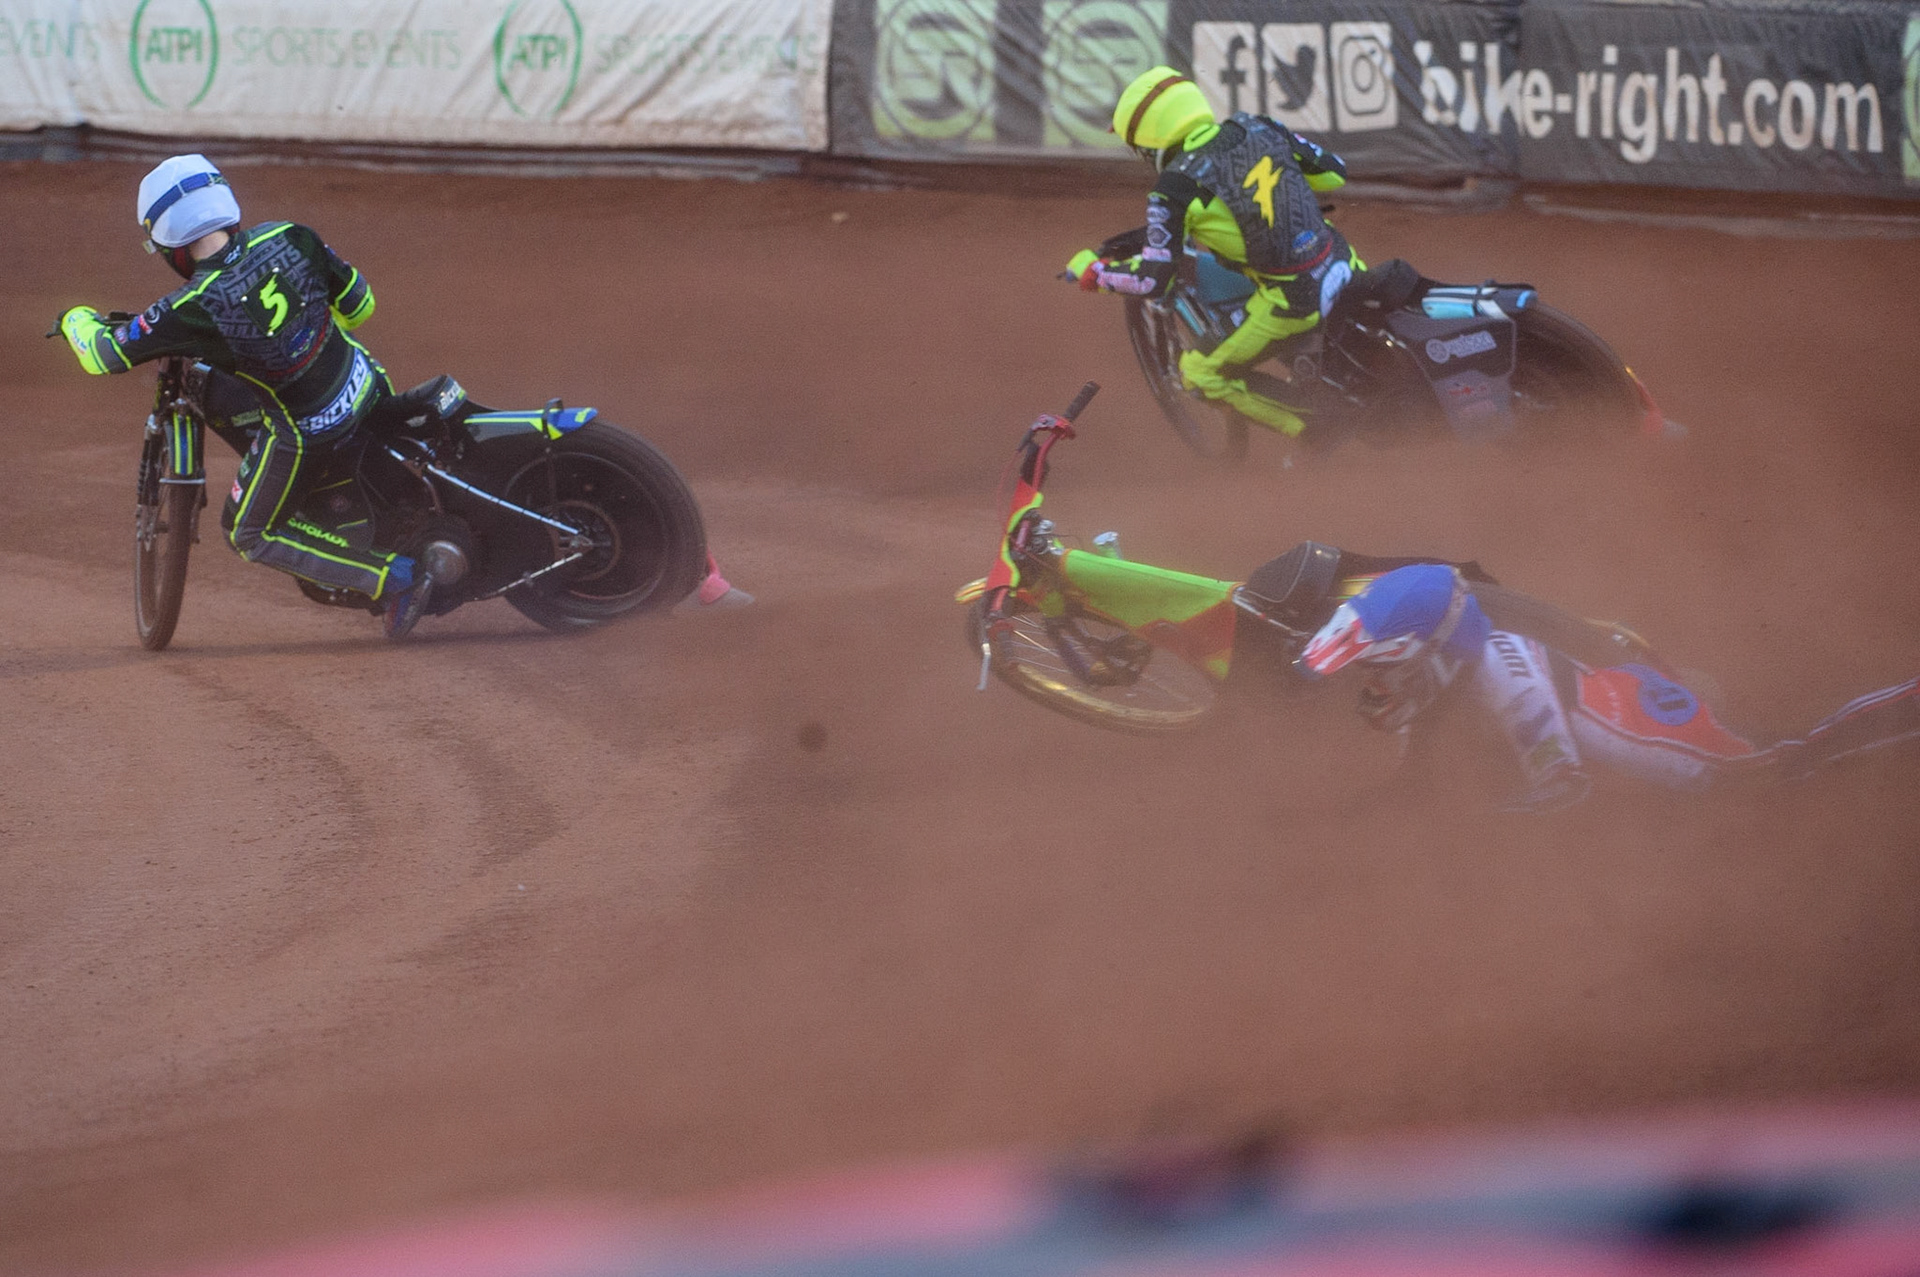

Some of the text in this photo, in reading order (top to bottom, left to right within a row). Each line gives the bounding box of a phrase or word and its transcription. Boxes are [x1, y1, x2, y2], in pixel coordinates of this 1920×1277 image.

[145, 27, 204, 64] ATPI
[231, 26, 346, 69] SPORTS
[507, 33, 569, 71] ATPI
[1413, 40, 1884, 163] bike-right.com
[259, 273, 289, 333] 5
[309, 353, 369, 432] BICKLEY
